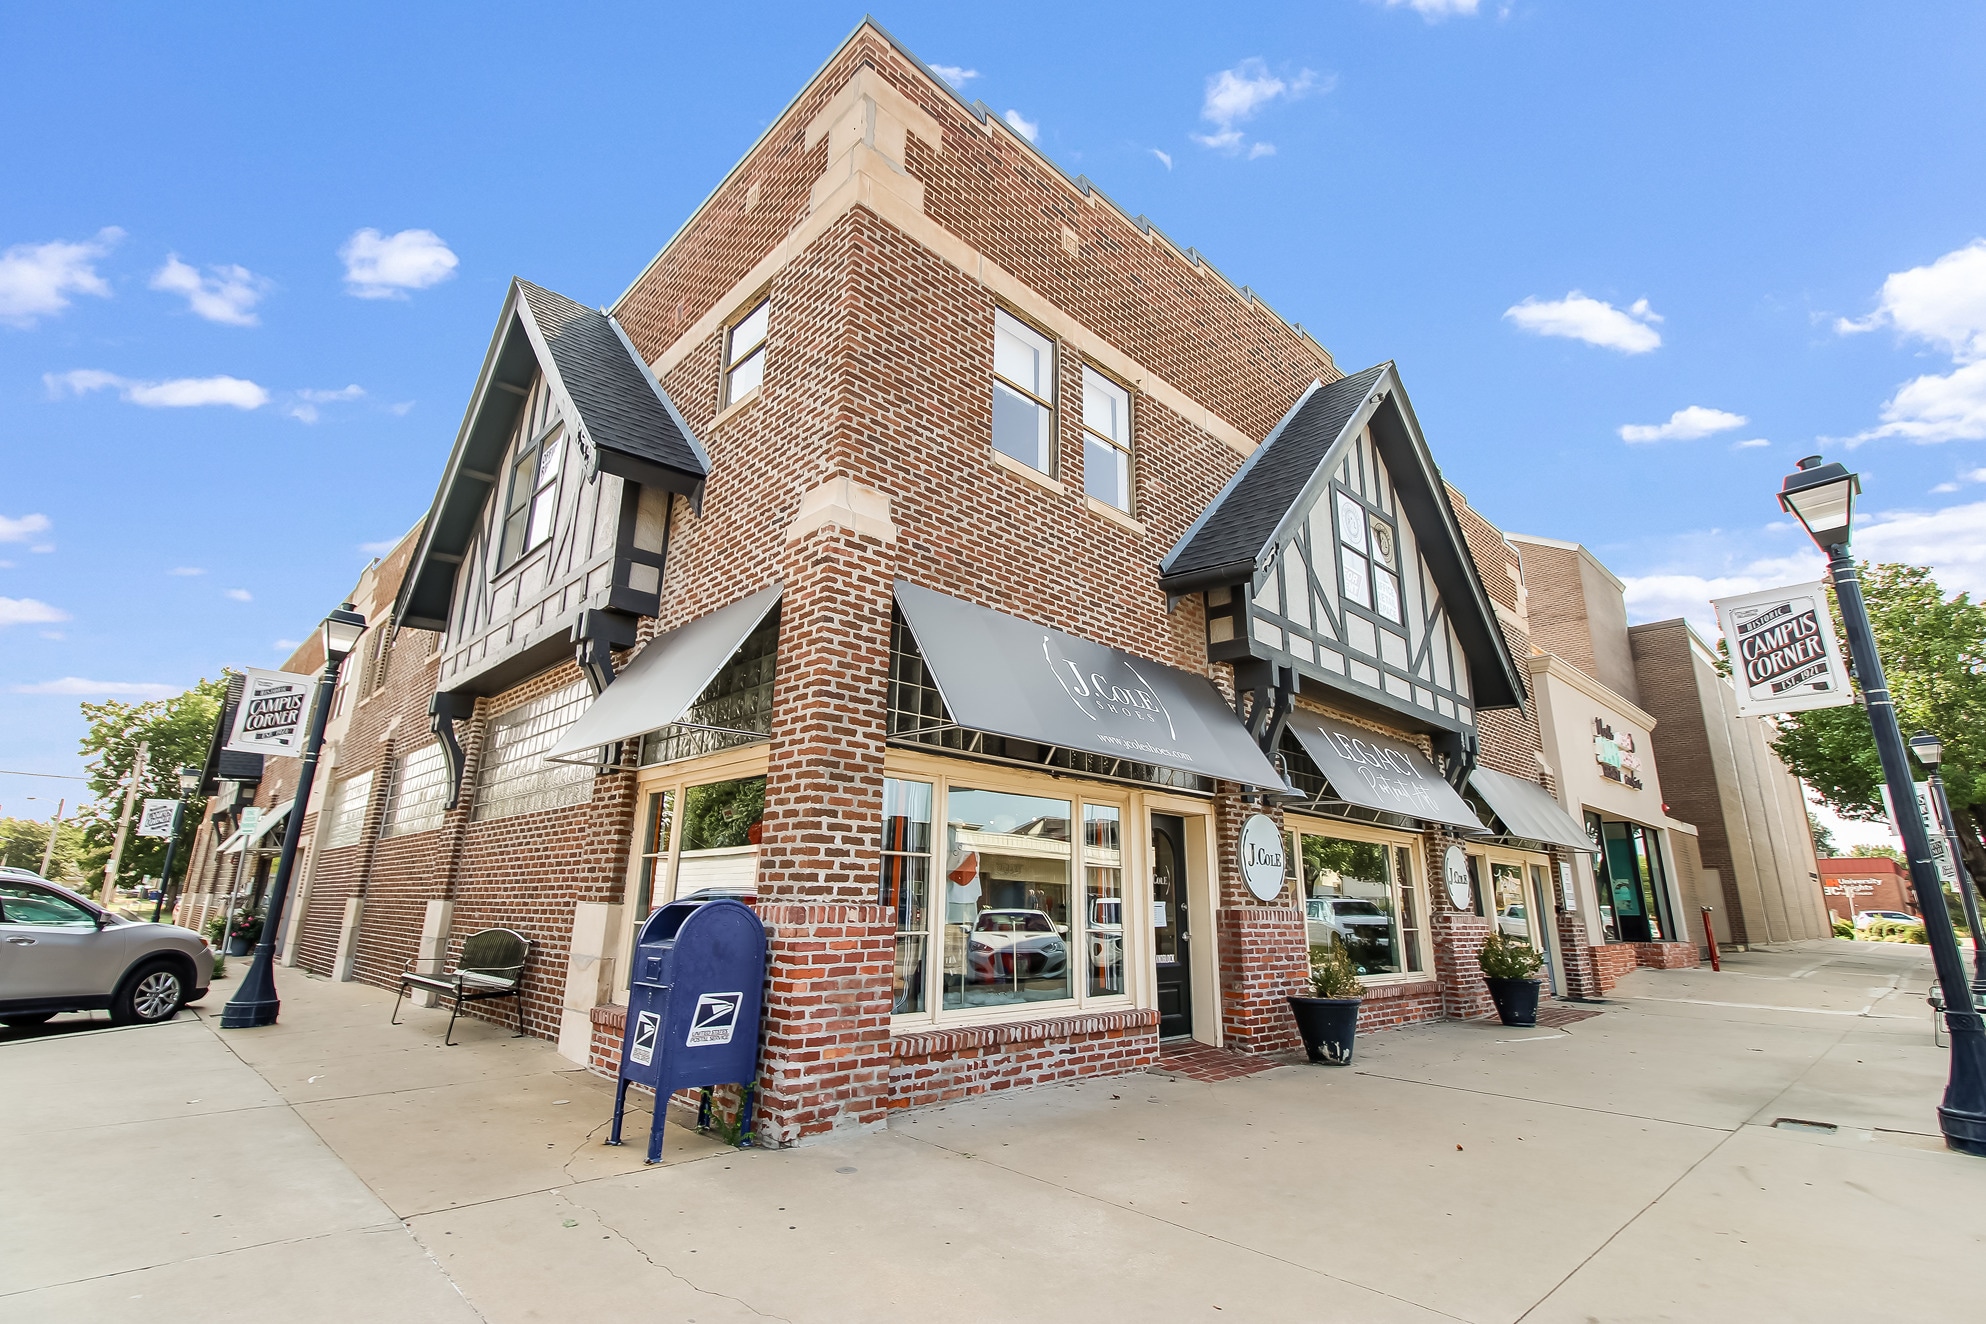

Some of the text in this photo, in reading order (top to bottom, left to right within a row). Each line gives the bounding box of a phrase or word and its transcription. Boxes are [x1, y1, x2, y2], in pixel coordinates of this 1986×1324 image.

[1345, 580, 1359, 595] ENT
[1746, 607, 1785, 631] HISTORIC
[1742, 612, 1818, 661] CAMPUS
[1747, 635, 1825, 683] CORNER
[1801, 665, 1819, 680] 1921
[249, 694, 303, 716] CAMPUS
[1095, 700, 1156, 723] SHOES
[245, 710, 299, 731] CORNER
[1096, 733, 1193, 761] www.jcoleshoes.com
[1317, 726, 1424, 780] LEGACY
[1838, 878, 1882, 886] University
